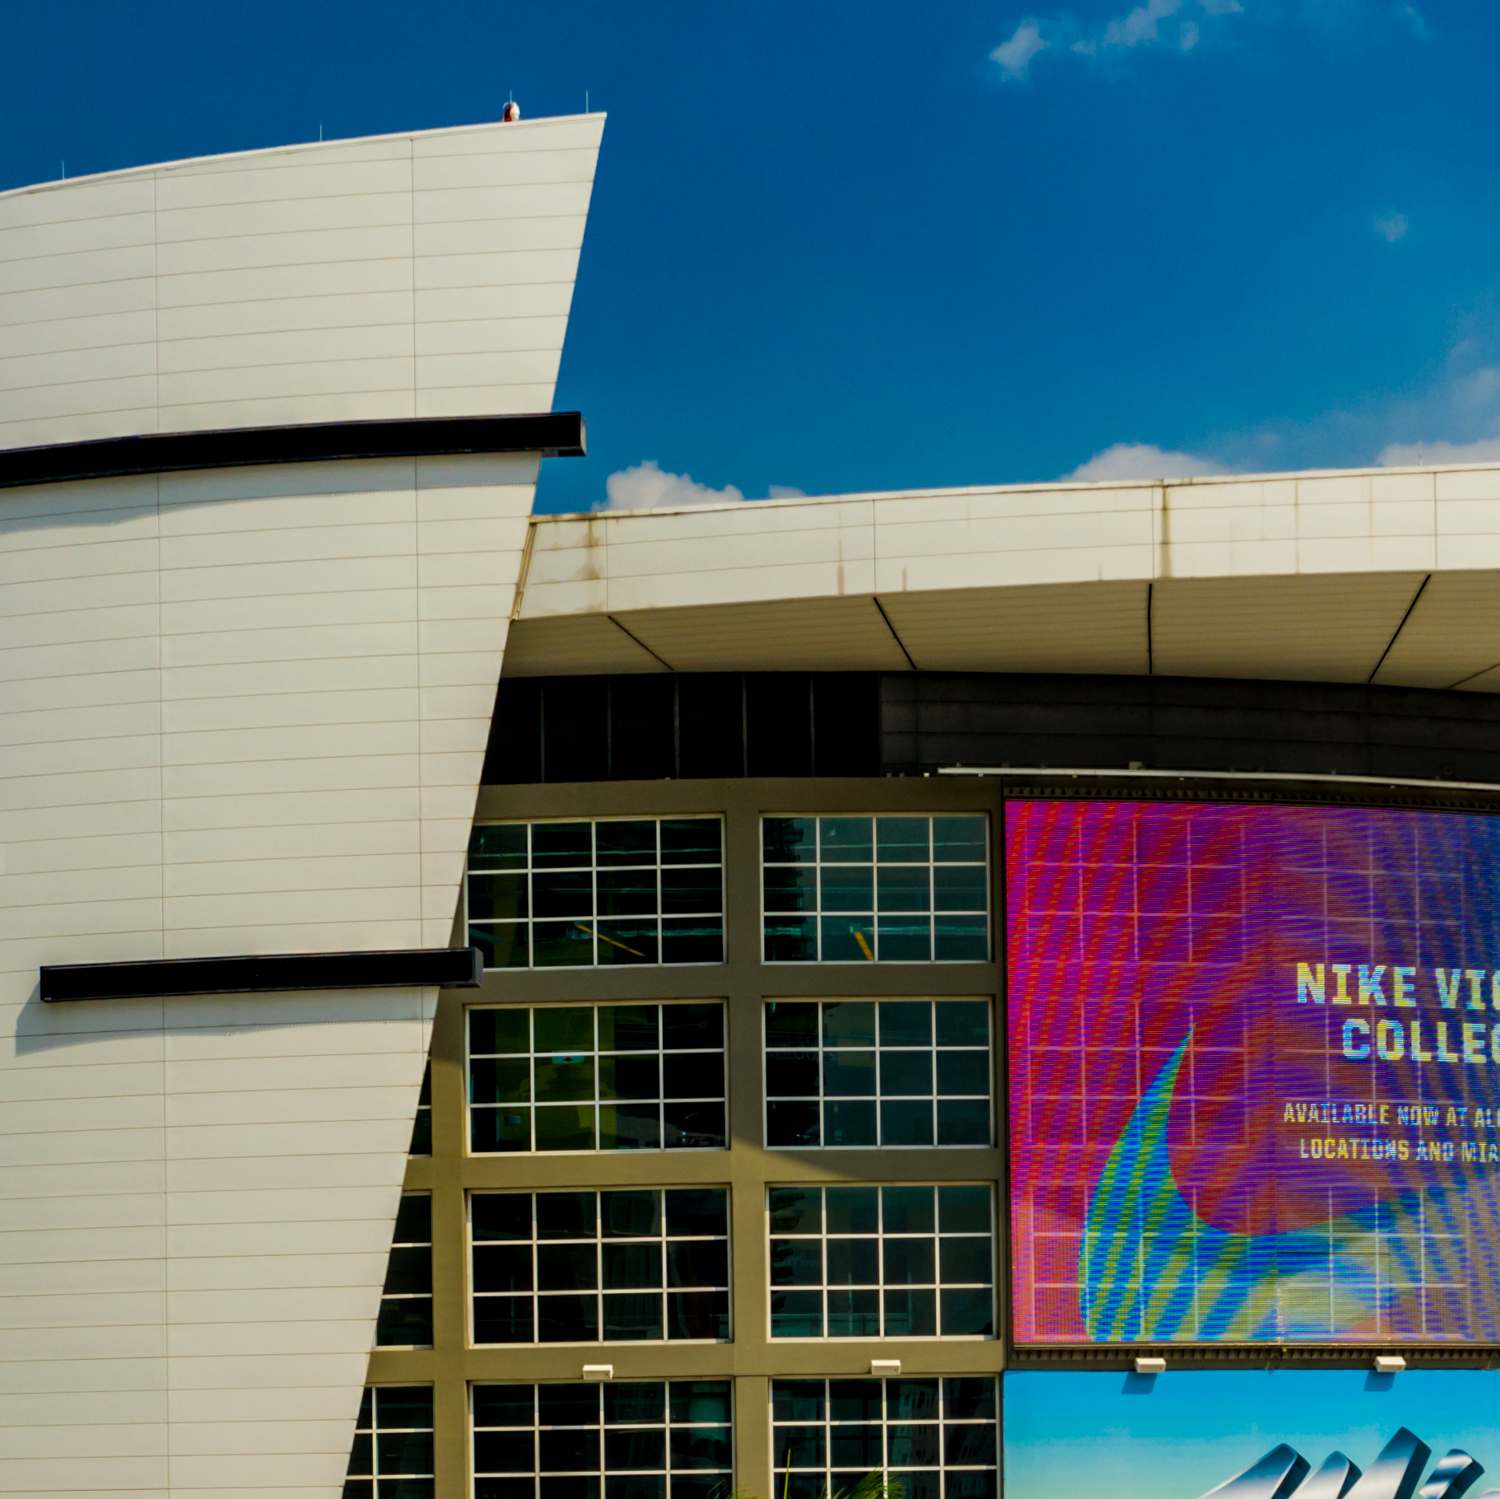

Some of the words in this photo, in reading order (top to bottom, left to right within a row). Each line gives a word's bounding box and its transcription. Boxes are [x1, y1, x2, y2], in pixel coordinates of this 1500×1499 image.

[1297, 963, 1416, 1007] NIKE
[1283, 1102, 1390, 1125] AVAILABLE
[1398, 1105, 1439, 1126] NOW
[1446, 1107, 1468, 1127] AT
[1300, 1138, 1410, 1161] LOCATIONS
[1416, 1140, 1454, 1162] AND
